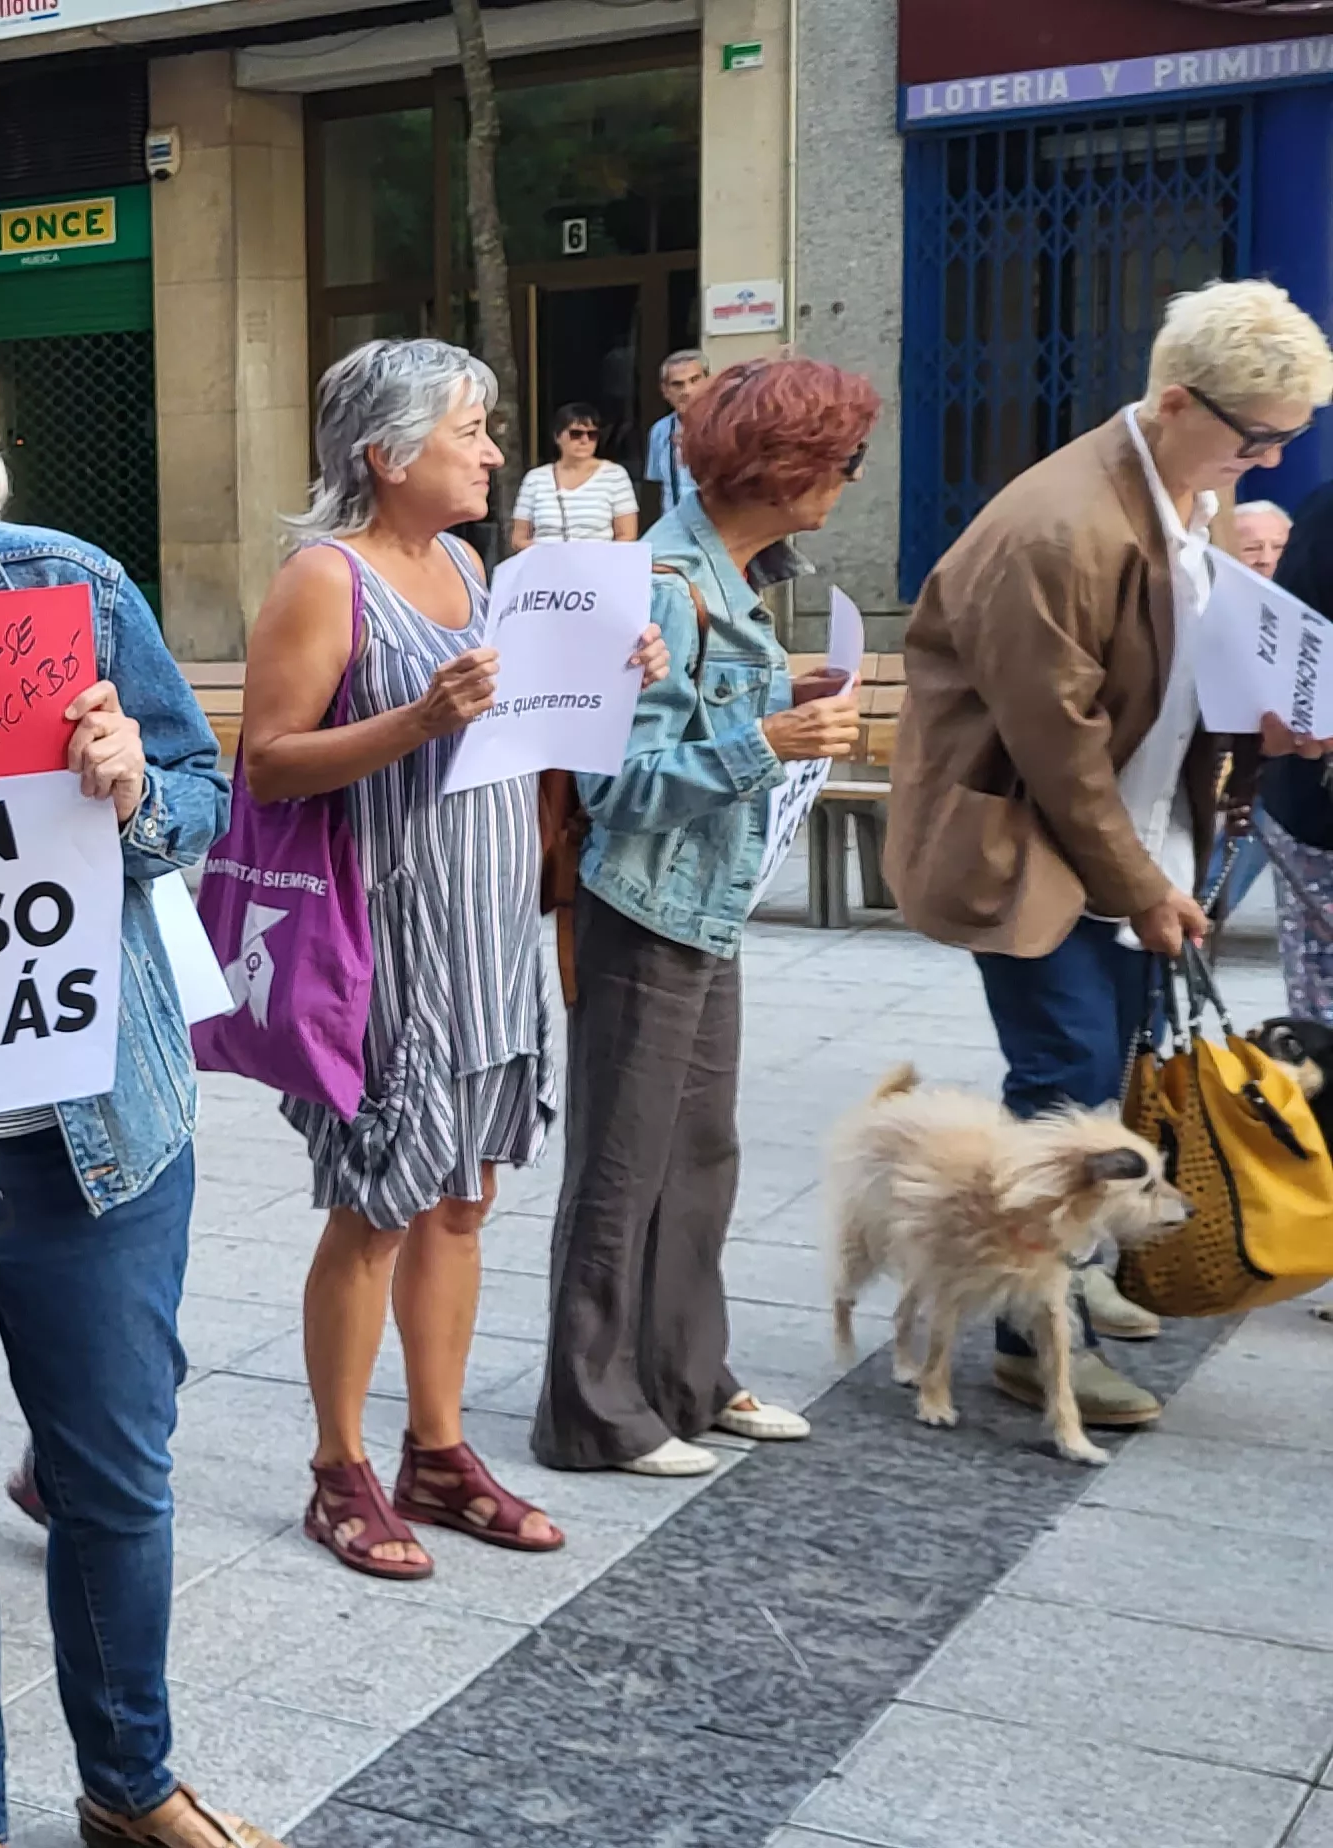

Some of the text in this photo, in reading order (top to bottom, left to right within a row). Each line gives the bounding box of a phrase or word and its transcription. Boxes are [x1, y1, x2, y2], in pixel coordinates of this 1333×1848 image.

[924, 69, 1069, 113] LOTERIA
[1100, 63, 1121, 93] Y
[9, 208, 104, 244] ONCE
[568, 222, 582, 249] 6
[520, 588, 598, 613] MENOS
[513, 693, 603, 719] queremos
